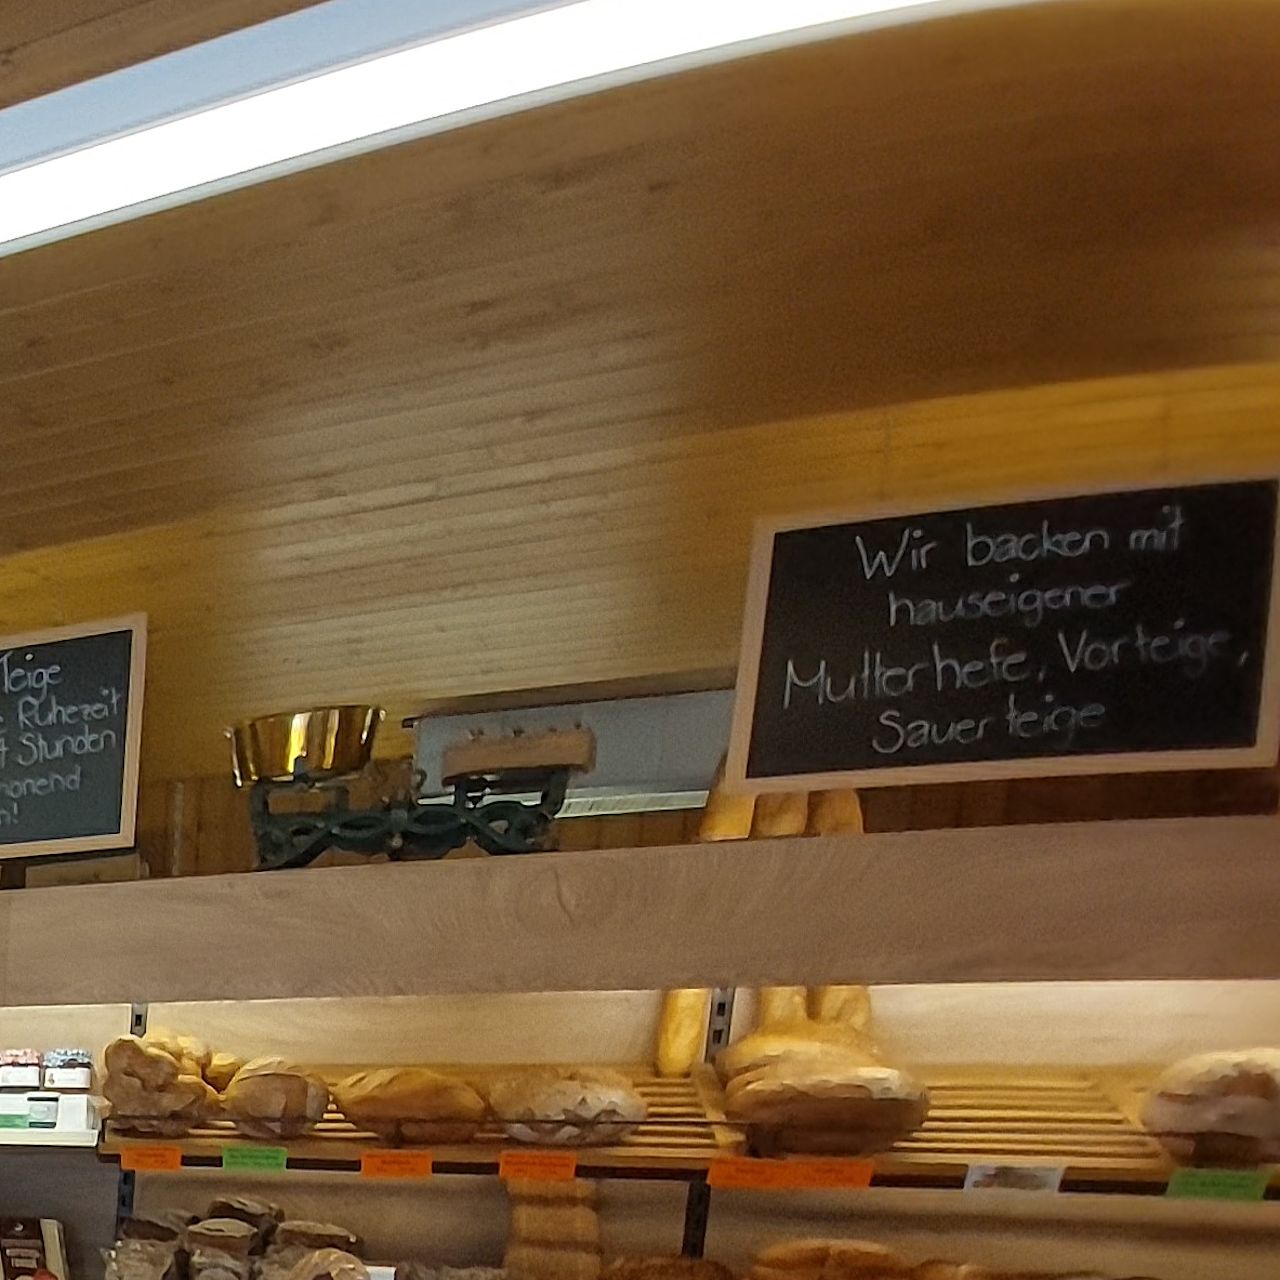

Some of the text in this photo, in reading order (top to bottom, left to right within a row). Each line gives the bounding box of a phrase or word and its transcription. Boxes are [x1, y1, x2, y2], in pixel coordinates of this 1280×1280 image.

[855, 505, 1185, 581] Wir backen mit
[888, 572, 1132, 628] hauseigener
[17, 687, 122, 730] Ruhezeit
[17, 724, 117, 767] Stunden
